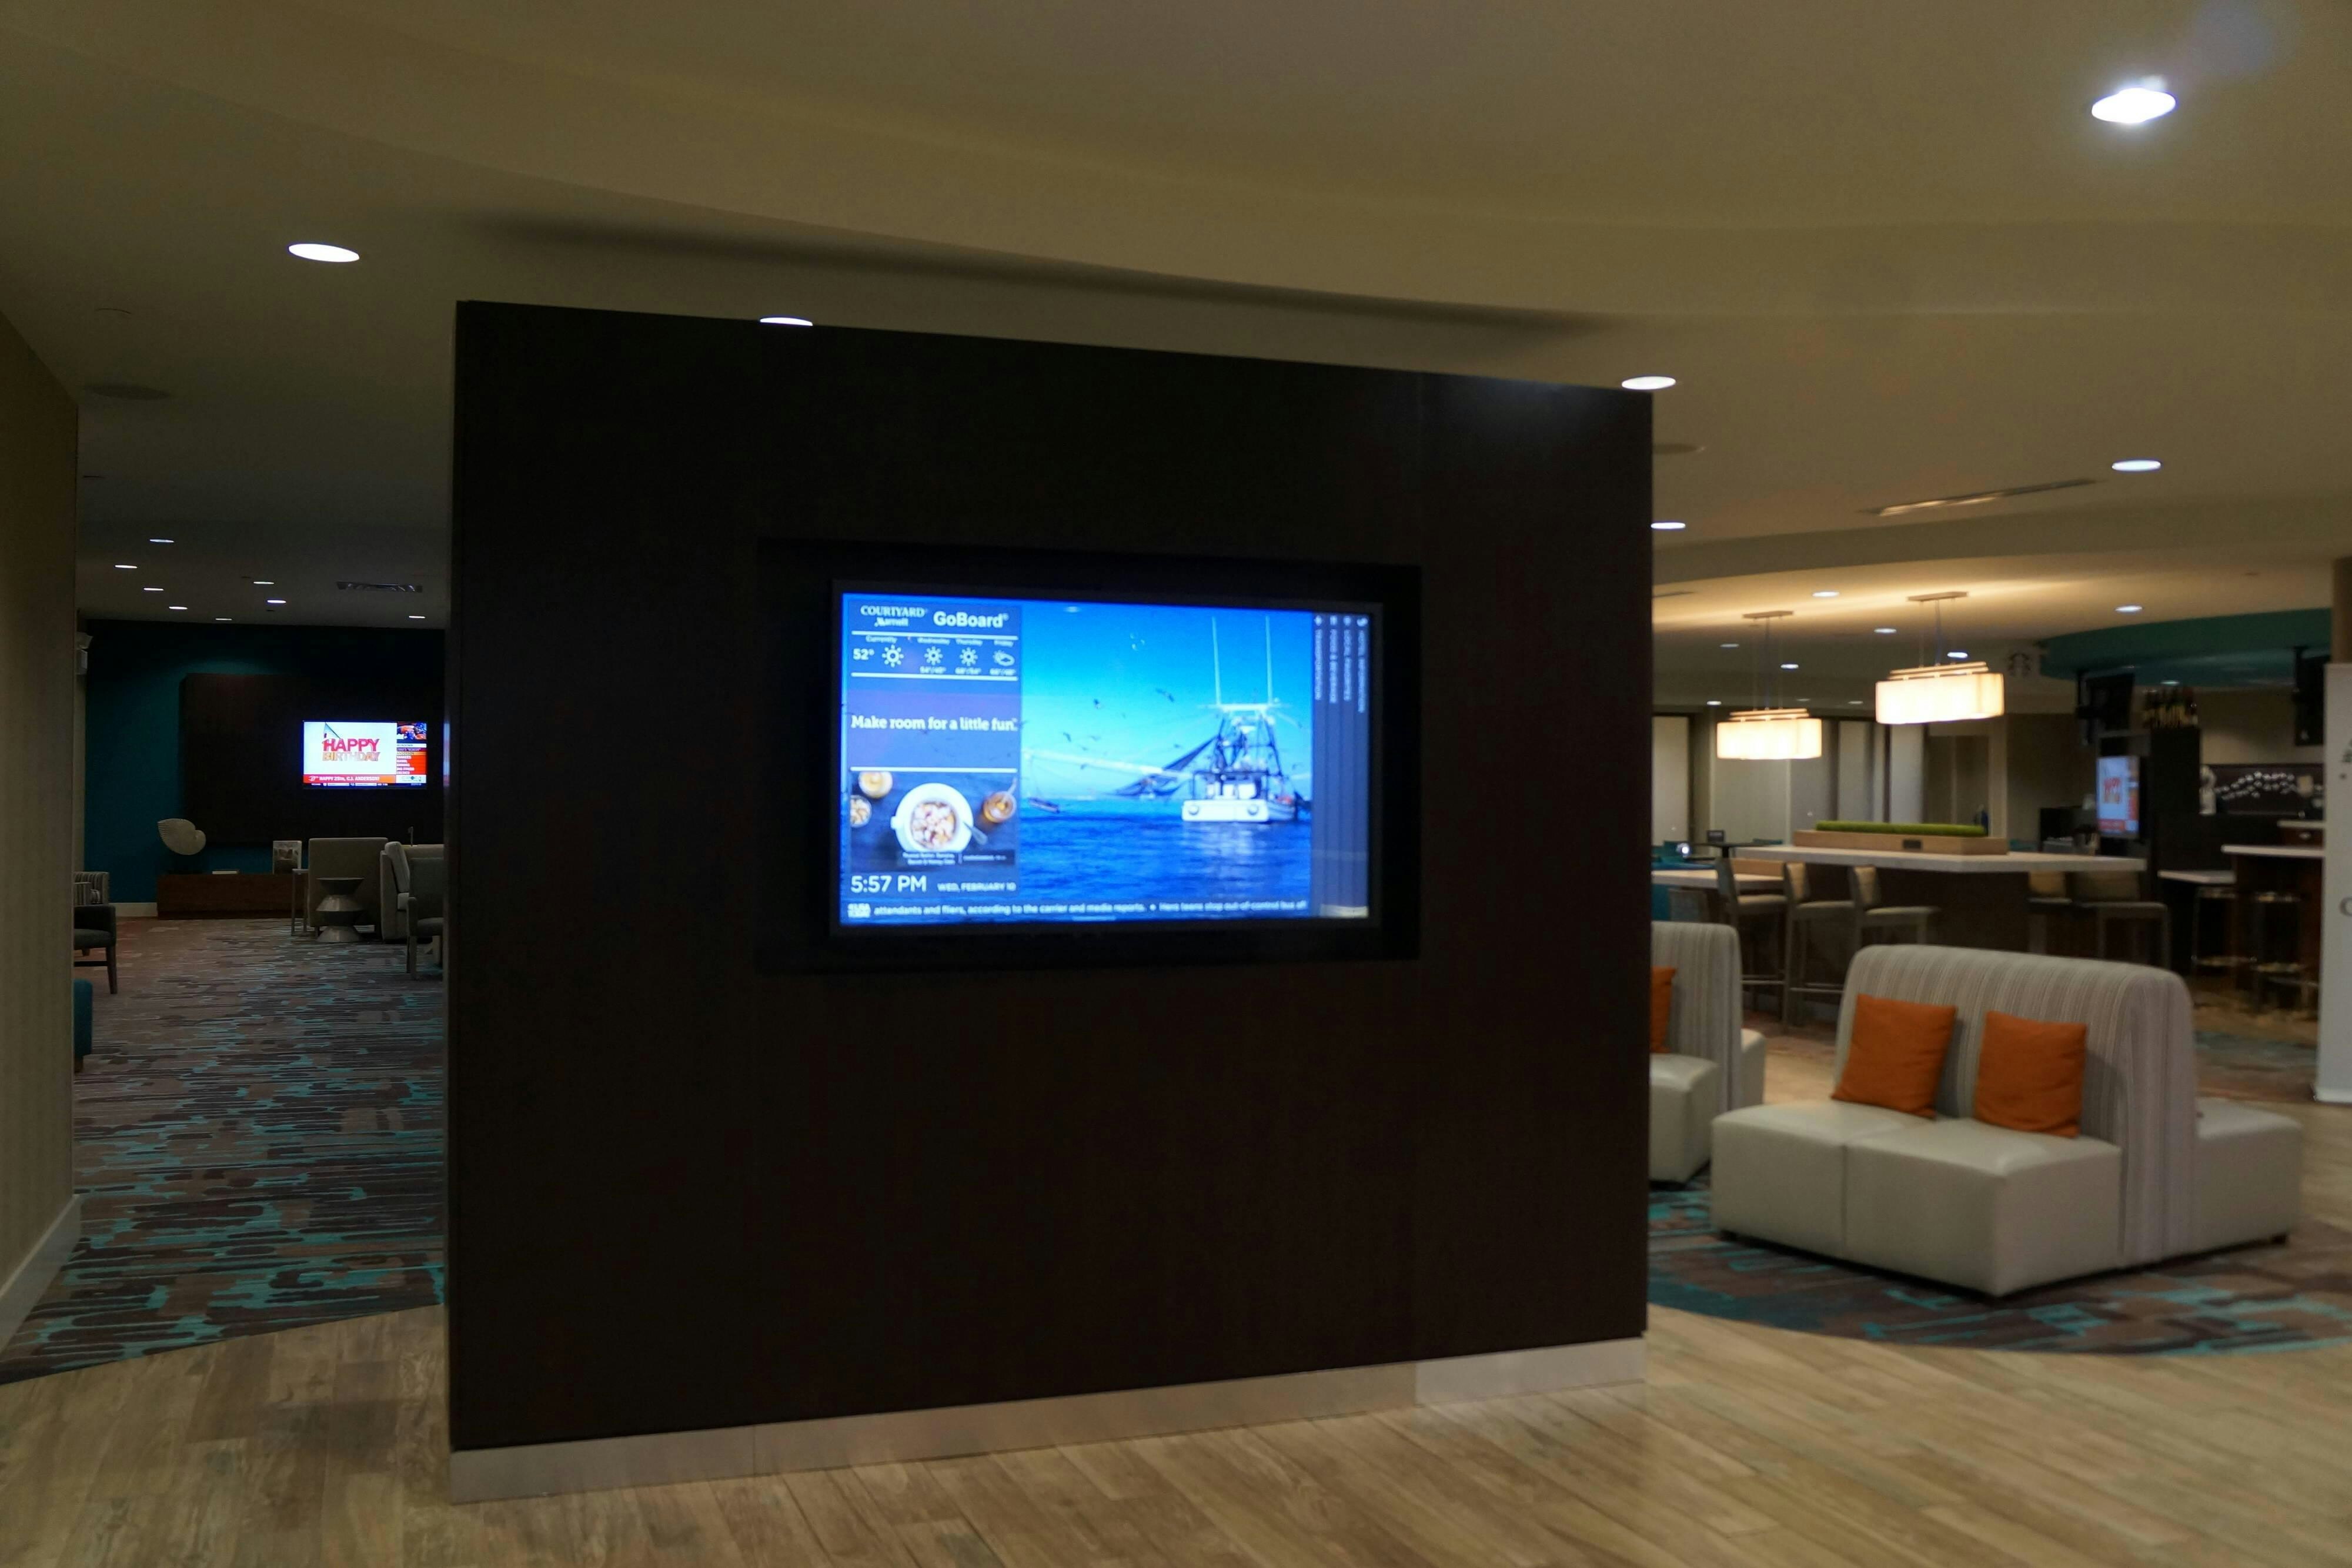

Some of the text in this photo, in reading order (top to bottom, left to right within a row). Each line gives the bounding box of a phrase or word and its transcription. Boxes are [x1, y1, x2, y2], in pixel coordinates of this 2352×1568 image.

[860, 606, 926, 617] COURTYARD
[851, 715, 887, 730] Make
[890, 718, 926, 730] room
[928, 716, 948, 730] for
[950, 720, 958, 730] a
[960, 717, 990, 731] little
[323, 738, 380, 751] HAPPY
[323, 752, 381, 761] BIRTHDAY
[851, 875, 927, 893] 5:57 PM
[961, 882, 1005, 892] FEBRUARY
[1006, 882, 1017, 891] 10
[874, 905, 922, 915] attendants
[923, 905, 940, 915] and
[941, 905, 967, 915] fliers,
[968, 904, 1011, 916] according
[1012, 904, 1023, 914] to
[1023, 904, 1038, 914] the
[1039, 903, 1068, 914] carrier
[1068, 903, 1085, 913] and
[1086, 902, 1112, 912] media
